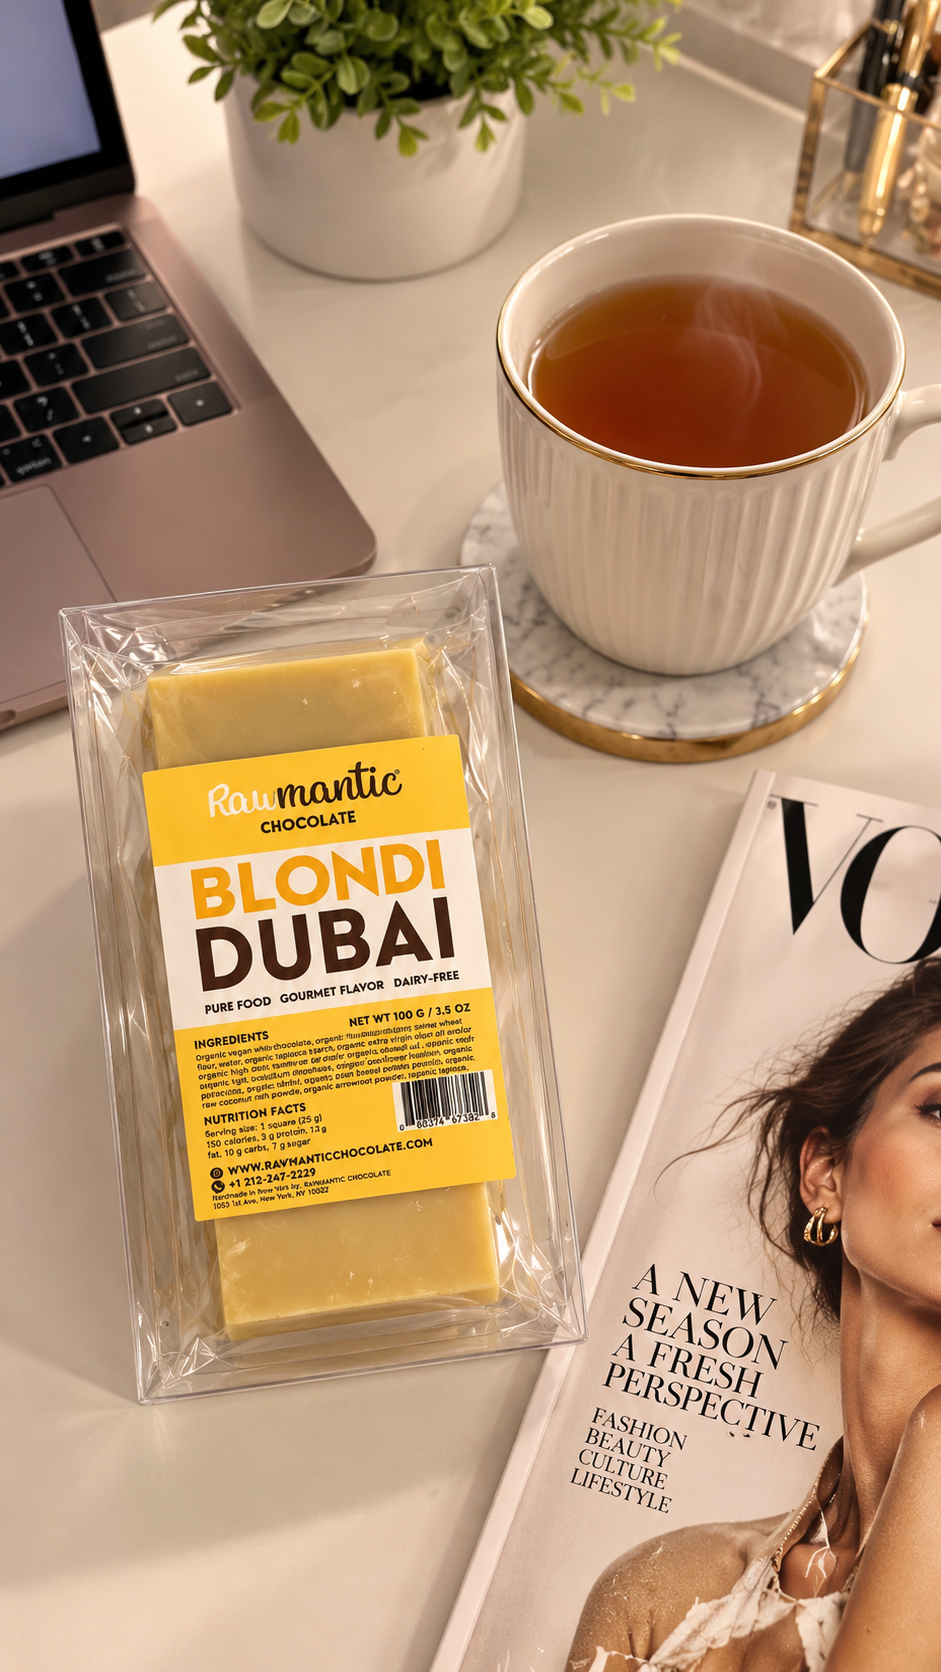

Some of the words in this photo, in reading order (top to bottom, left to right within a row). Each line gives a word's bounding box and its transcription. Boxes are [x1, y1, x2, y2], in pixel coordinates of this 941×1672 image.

[207, 761, 403, 818] Rawmantic
[260, 810, 357, 834] CHOCOLATE
[190, 838, 446, 920] BLONDI
[769, 793, 941, 965] VO
[195, 896, 455, 992] DUBAI
[204, 1001, 234, 1015] PURE
[236, 996, 272, 1011] FOOD
[279, 986, 337, 1004] GOURMET
[340, 980, 385, 995] FLAVOR
[393, 970, 460, 988] DAIRY-FREE
[349, 1015, 370, 1028] NET
[372, 1012, 391, 1025] WT
[393, 1010, 413, 1022] 100
[415, 1008, 425, 1018] G
[427, 1007, 433, 1019] /
[435, 1004, 451, 1017] 3.5
[454, 1002, 471, 1014] OZ
[194, 1030, 269, 1050] INGREDIENTS
[204, 1108, 267, 1126] NUTRITION
[271, 1102, 306, 1116] FACTS
[229, 1179, 241, 1188] +1
[244, 1167, 316, 1187] 212-247-2229
[347, 1170, 391, 1181] CHOCOLATE
[631, 1263, 660, 1297] A
[672, 1270, 778, 1326] NEW
[621, 1296, 789, 1370] SEASON
[611, 1333, 636, 1362] A
[647, 1340, 764, 1399] FRESH
[591, 1406, 688, 1450] FASHION
[602, 1361, 821, 1451] PERSPECTIVE
[578, 1448, 669, 1490] CULTURE
[584, 1427, 672, 1468] BEAUTY
[570, 1467, 673, 1514] LIFESTYLE
